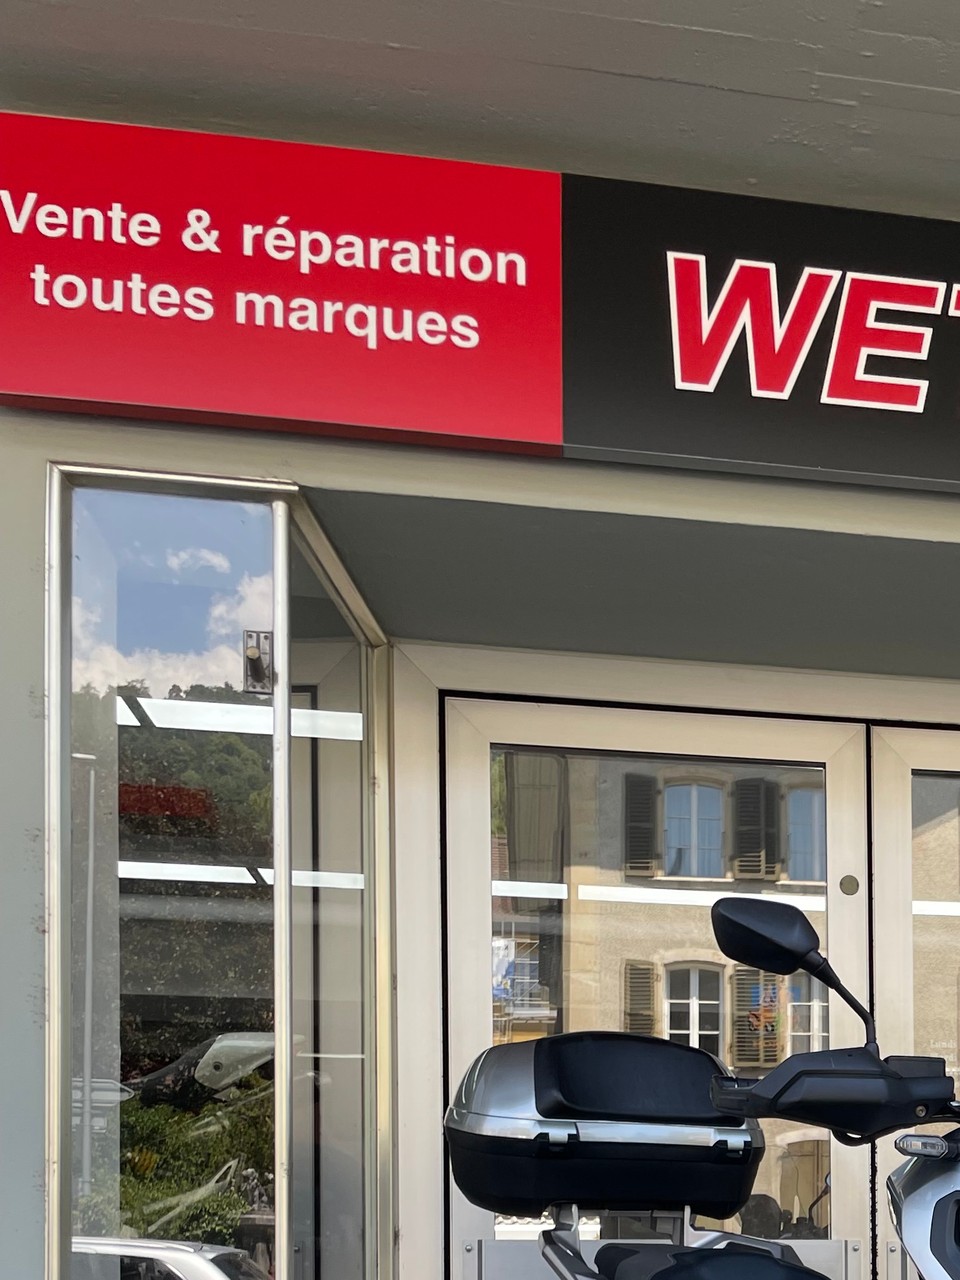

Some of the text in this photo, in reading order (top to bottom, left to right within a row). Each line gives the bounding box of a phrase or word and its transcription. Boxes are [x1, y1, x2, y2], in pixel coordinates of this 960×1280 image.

[0, 189, 527, 286] Vente & réparation
[30, 264, 480, 349] toutes marques
